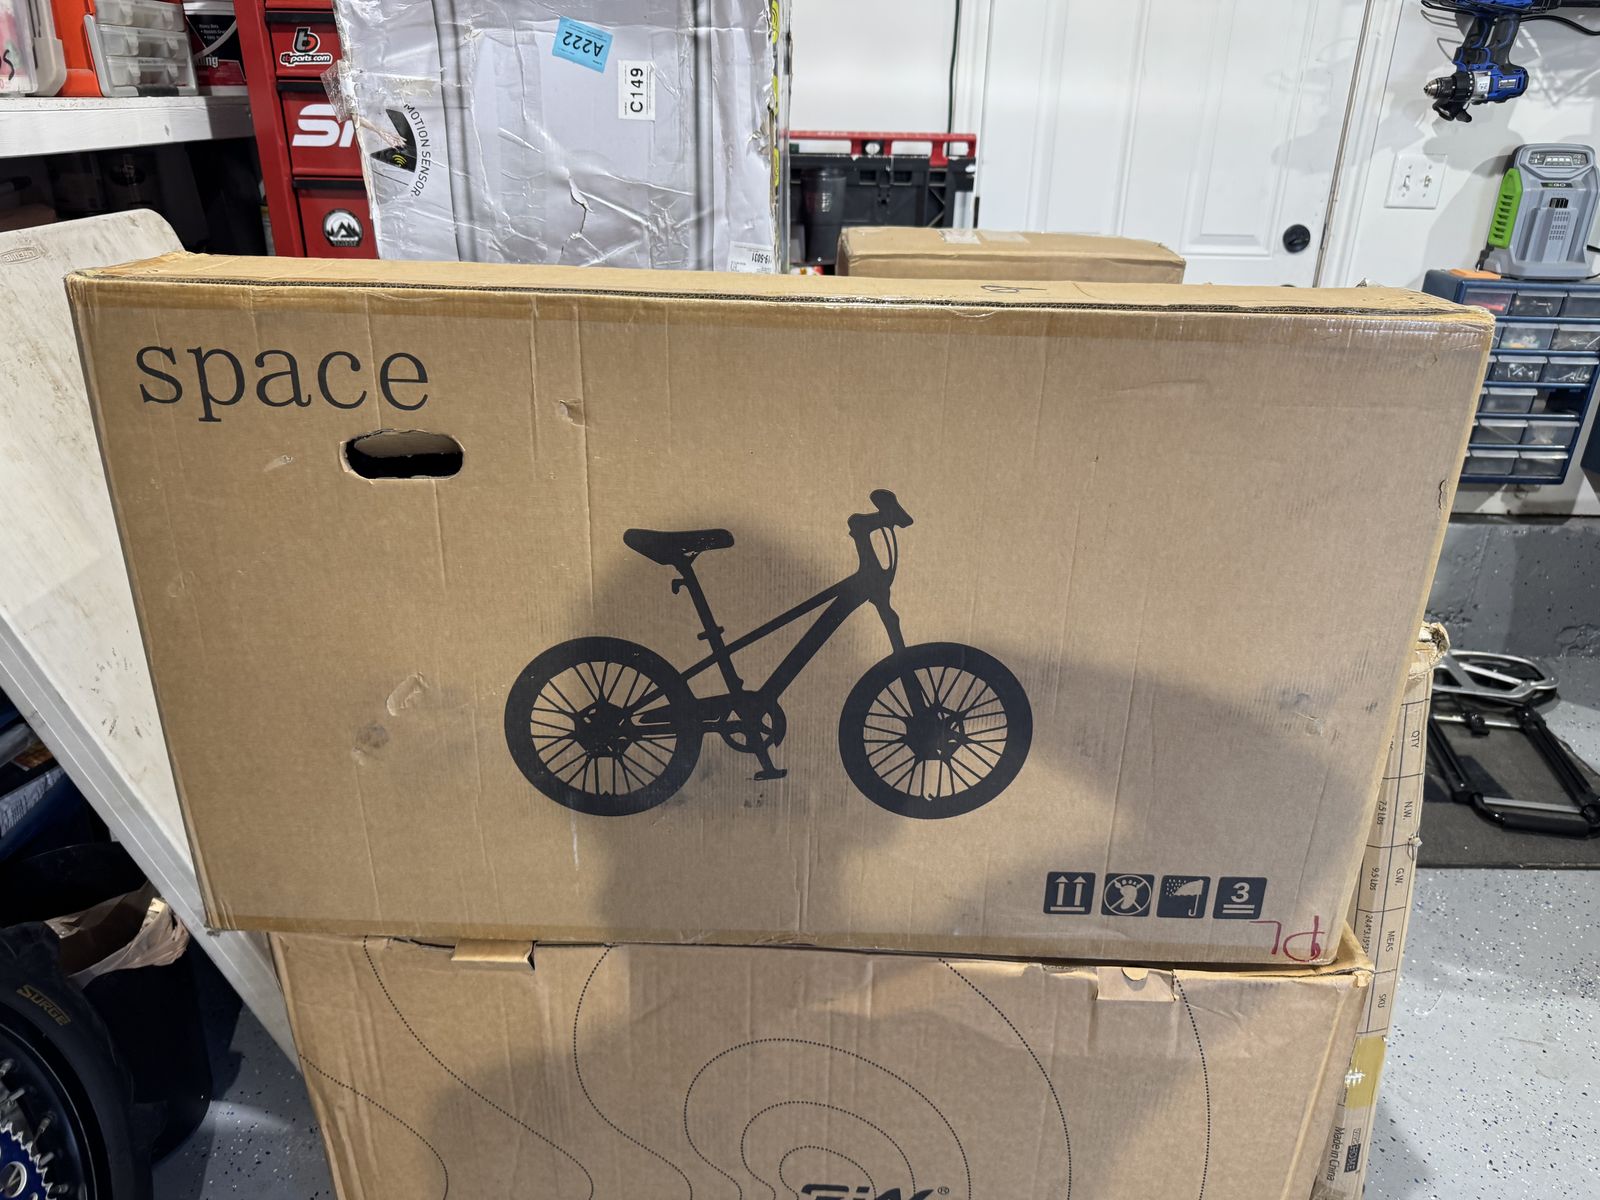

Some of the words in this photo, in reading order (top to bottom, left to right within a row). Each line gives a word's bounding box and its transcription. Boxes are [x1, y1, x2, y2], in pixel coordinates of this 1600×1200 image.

[562, 31, 604, 57] A222
[630, 67, 644, 113] C149
[403, 103, 431, 147] MOTION
[410, 150, 431, 197] SENSOR
[136, 345, 429, 422] space
[1411, 730, 1420, 748] QTY
[1378, 800, 1387, 811] 7.5
[1403, 801, 1413, 820] N.W.
[1376, 812, 1386, 825] Lbs
[1371, 867, 1380, 878] 9.5
[1395, 867, 1404, 886] G.W.
[1231, 882, 1251, 903] 3
[1369, 878, 1378, 891] Lbs
[1385, 930, 1396, 953] MEAS
[16, 984, 71, 1026] SURGE
[1377, 993, 1387, 1008] SKU
[1332, 1126, 1345, 1150] Made
[1330, 1150, 1340, 1160] in
[1327, 1160, 1340, 1181] China
